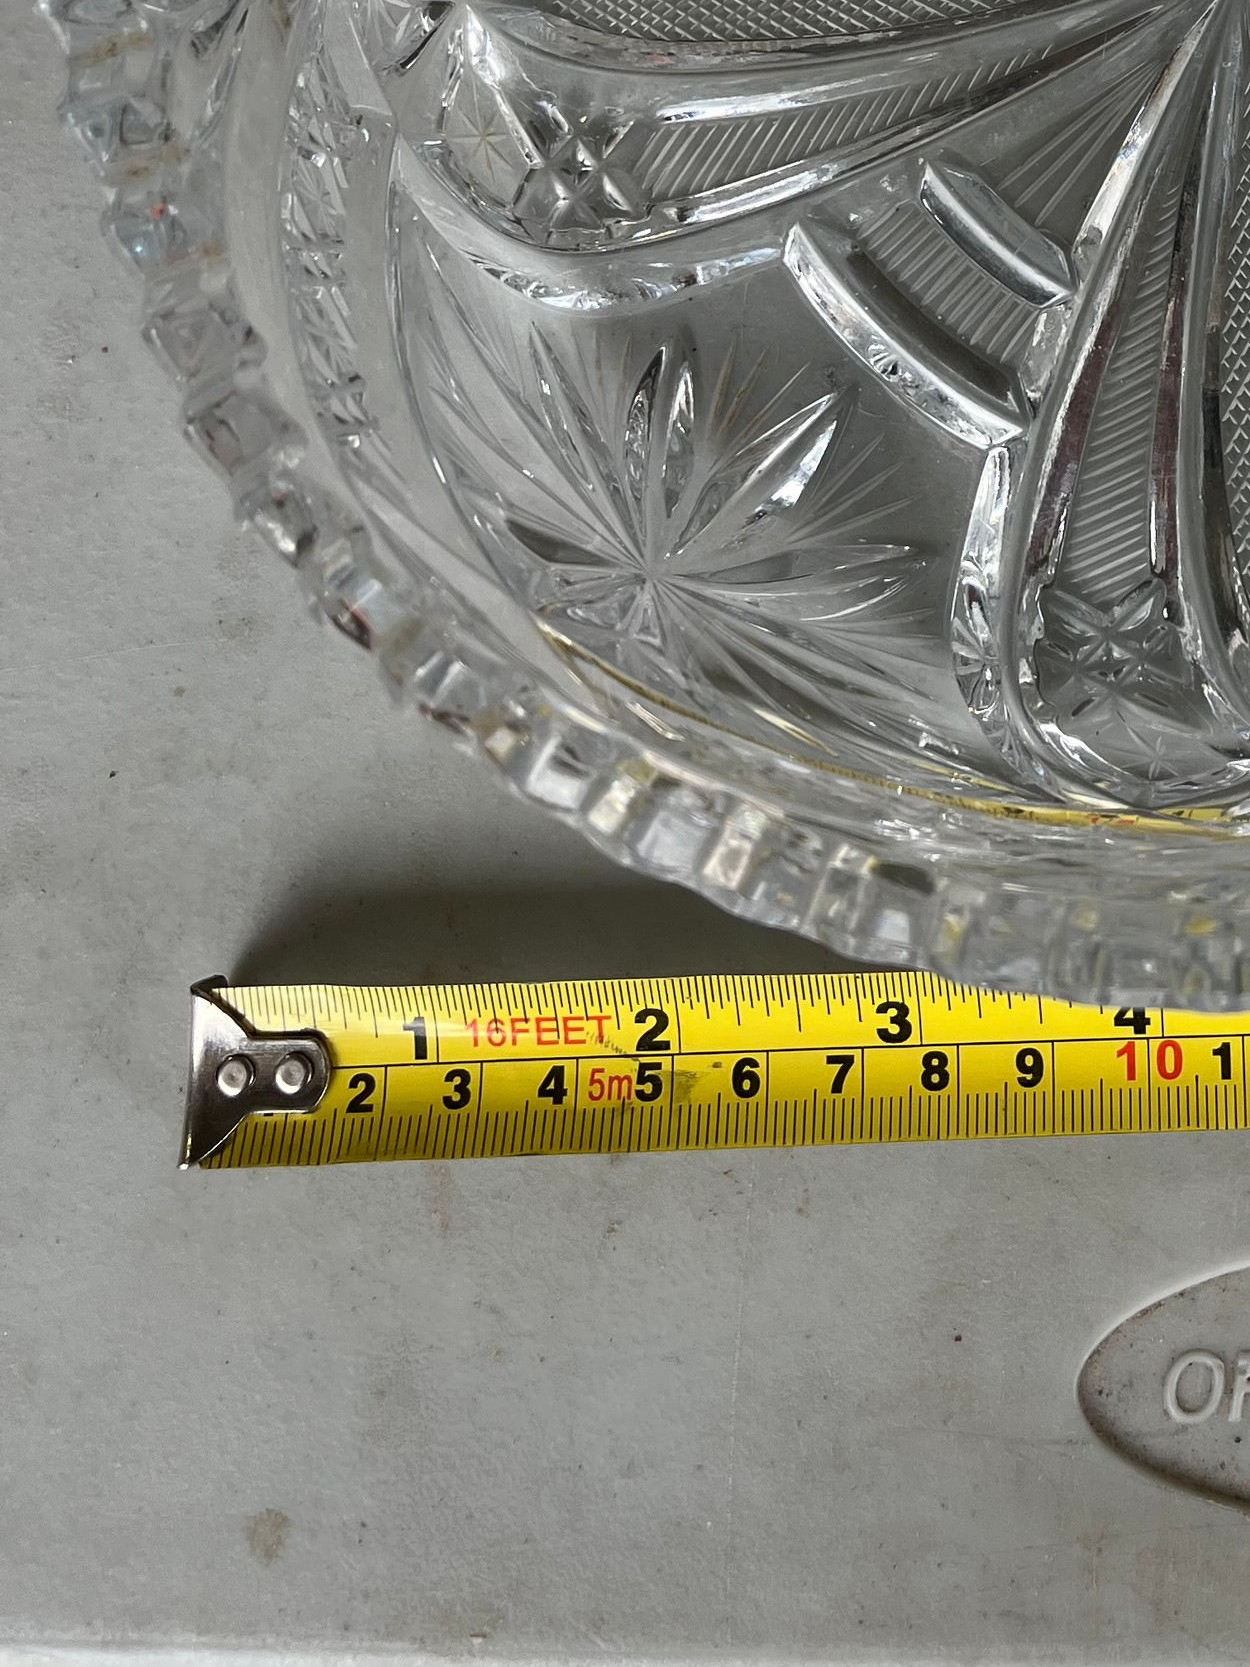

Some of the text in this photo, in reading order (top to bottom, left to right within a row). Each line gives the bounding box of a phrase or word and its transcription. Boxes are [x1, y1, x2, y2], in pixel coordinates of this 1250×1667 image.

[404, 1016, 428, 1060] 1
[635, 1009, 670, 1051] 2
[876, 1001, 912, 1044] 3
[1114, 1006, 1151, 1034] 4
[465, 1015, 612, 1048] 16FEET
[346, 1073, 374, 1114] 2
[443, 1068, 471, 1110] 3
[538, 1065, 568, 1105] 4
[635, 1061, 663, 1103] 5
[731, 1058, 760, 1099] 6
[826, 1055, 856, 1094] 7
[920, 1050, 950, 1093] 8
[1015, 1047, 1044, 1089] 9
[1116, 1039, 1183, 1082] 10
[1211, 1042, 1232, 1081] 1
[588, 1067, 633, 1104] 5m
